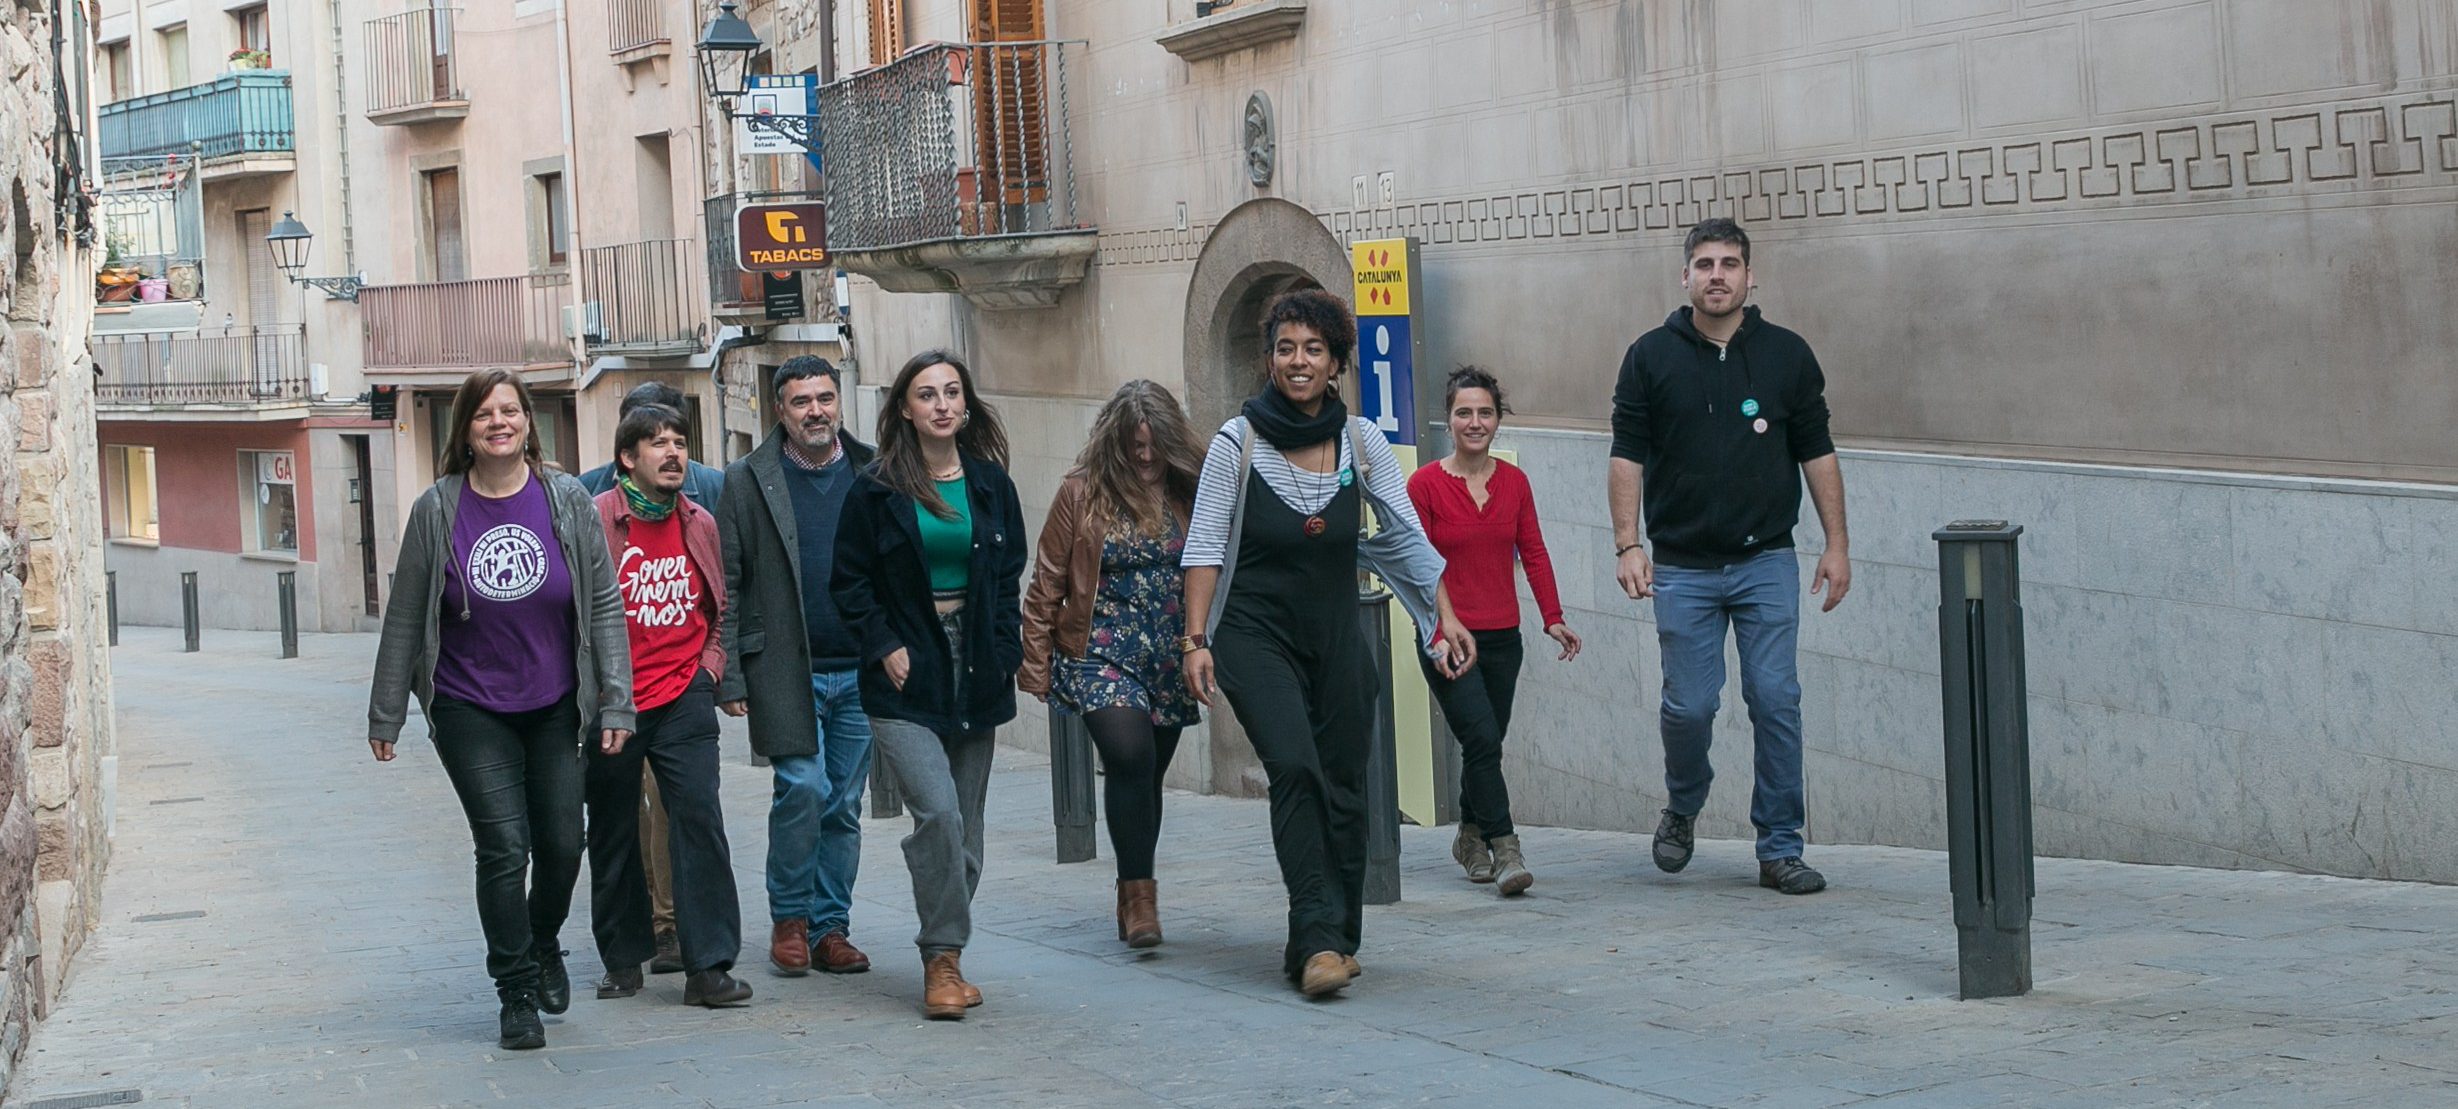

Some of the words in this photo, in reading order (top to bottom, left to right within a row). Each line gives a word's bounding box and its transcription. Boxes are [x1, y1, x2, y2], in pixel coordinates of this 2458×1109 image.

[1355, 181, 1365, 206] 11
[1380, 178, 1393, 203] 13
[750, 248, 825, 264] TABACS
[1357, 269, 1402, 285] CATALUNYA
[511, 528, 521, 537] US
[521, 531, 541, 551] VOLEM
[617, 546, 693, 602] Gover
[634, 577, 700, 604] nem
